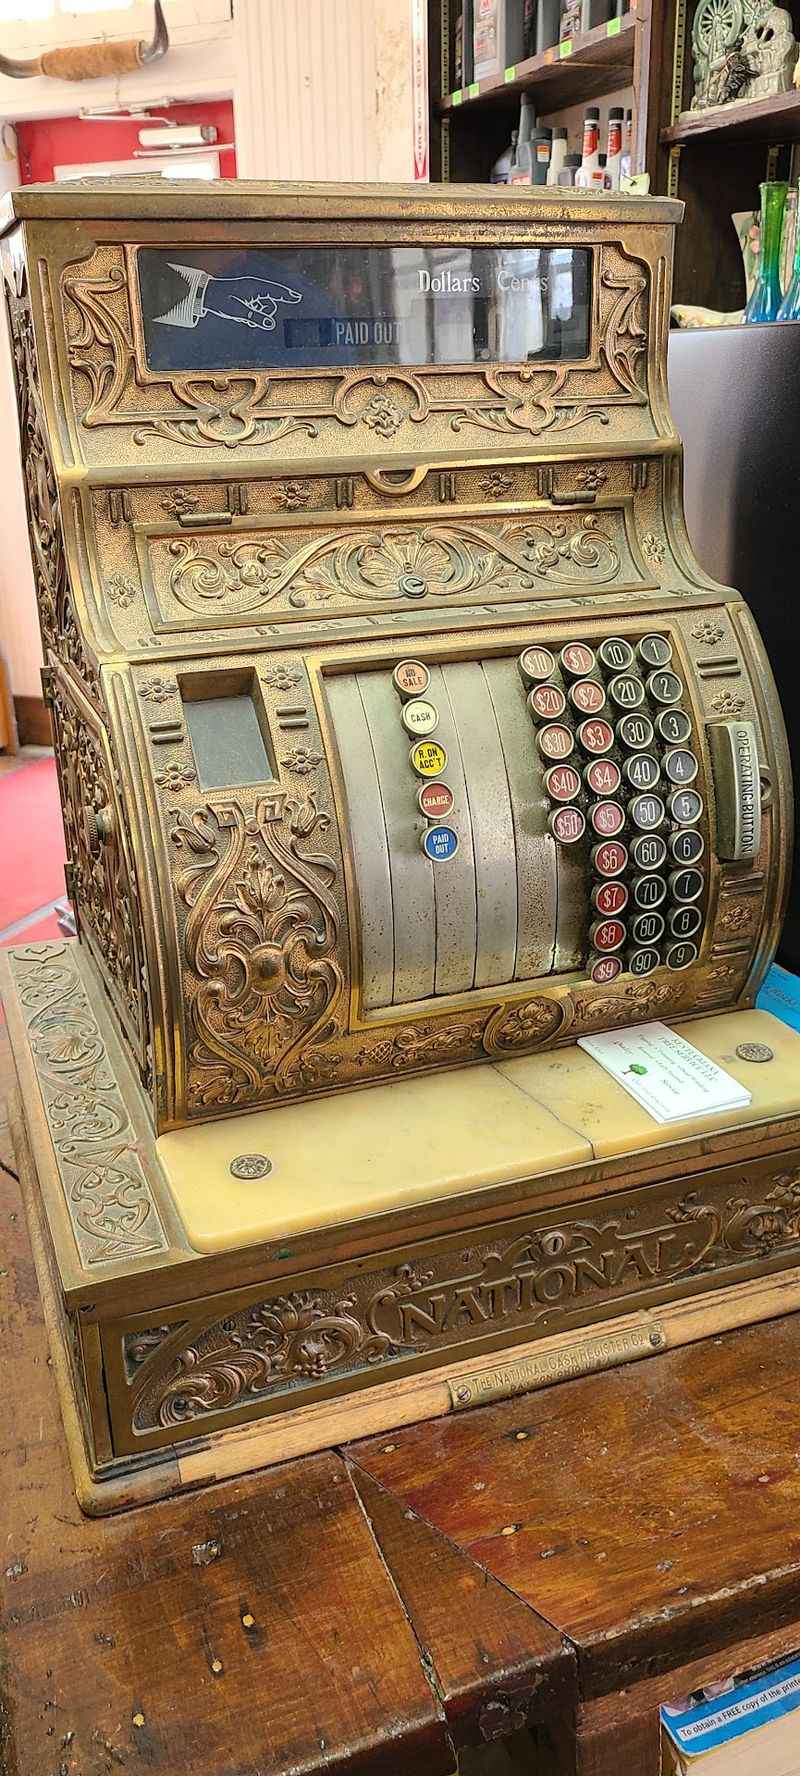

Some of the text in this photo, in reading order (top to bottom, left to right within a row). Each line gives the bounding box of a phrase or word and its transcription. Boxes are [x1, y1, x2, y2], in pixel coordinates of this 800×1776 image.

[417, 269, 549, 292] Dollars Cens
[335, 321, 369, 344] PAID
[570, 649, 586, 667] $1
[610, 645, 624, 664] 10
[651, 641, 659, 659] 1
[526, 654, 547, 672] $10
[403, 676, 424, 687] SALE
[618, 681, 636, 702] 20
[660, 677, 671, 697] 2
[536, 690, 559, 712] $20
[578, 687, 597, 707] $2
[410, 712, 431, 723] CASH
[669, 717, 679, 737] 3
[543, 731, 566, 752] $30
[586, 726, 605, 746] $3
[628, 722, 644, 743] 30
[419, 758, 442, 769] ACC'T
[633, 762, 650, 782] 40
[675, 757, 684, 777] 4
[552, 773, 575, 793] $40
[594, 766, 612, 786] $4
[423, 795, 449, 808] CHARGE
[736, 730, 755, 853] OPERATING BUTTON
[599, 805, 615, 826] $5
[638, 801, 656, 822] 50
[681, 796, 691, 817] 5
[556, 813, 578, 835] $50
[432, 833, 449, 844] PAID
[435, 843, 449, 854] OUT
[683, 838, 692, 857] 6
[602, 848, 618, 869] $6
[641, 841, 658, 862] 60
[642, 880, 658, 901] 70
[683, 874, 692, 894] 7
[603, 886, 619, 908] $7
[639, 918, 656, 937] 80
[681, 913, 690, 930] 8
[600, 925, 616, 944] $8
[636, 953, 651, 971] 90
[676, 947, 686, 964] 9
[597, 960, 614, 978] $9
[400, 1234, 694, 1342] NATIONAL
[472, 1378, 492, 1392] THE
[494, 1363, 547, 1387] NATIONAL
[548, 1352, 577, 1370] CASH
[579, 1339, 629, 1361] REGISTER
[681, 1728, 692, 1738] To
[693, 1717, 717, 1733] obtain
[722, 1706, 742, 1720] FREE
[742, 1700, 760, 1711] copy
[760, 1693, 769, 1702] of
[769, 1688, 783, 1699] the
